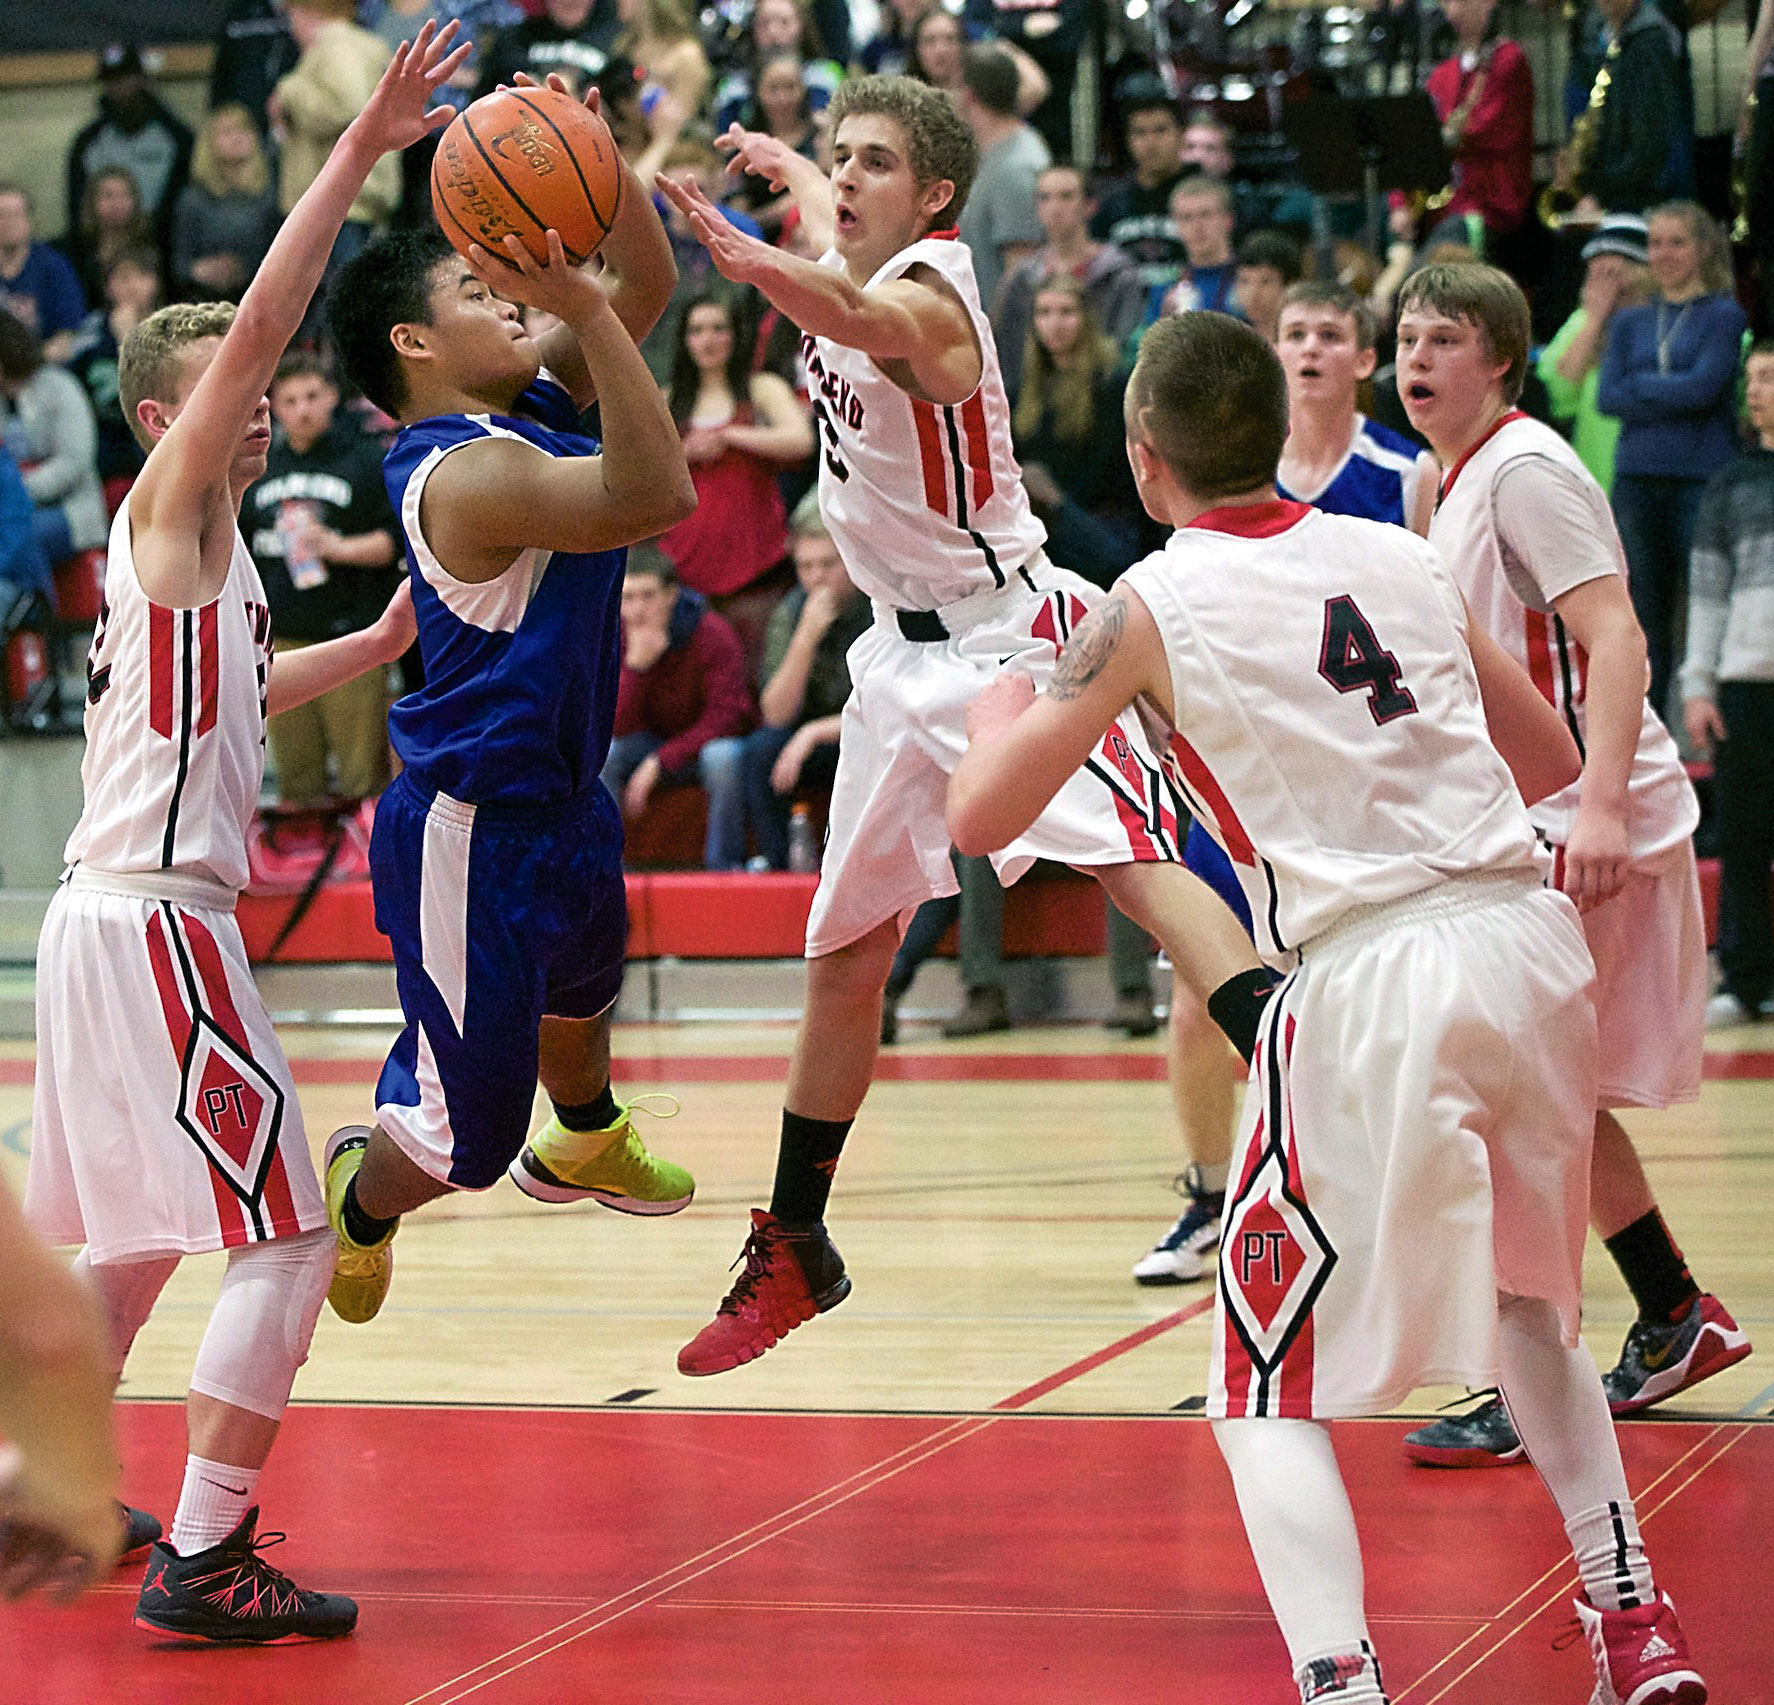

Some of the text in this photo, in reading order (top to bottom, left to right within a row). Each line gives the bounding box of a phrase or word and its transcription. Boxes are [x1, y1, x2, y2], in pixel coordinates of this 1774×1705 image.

[1317, 593, 1419, 727] 4
[203, 1082, 249, 1135] PT
[1241, 1229, 1288, 1286] PT
